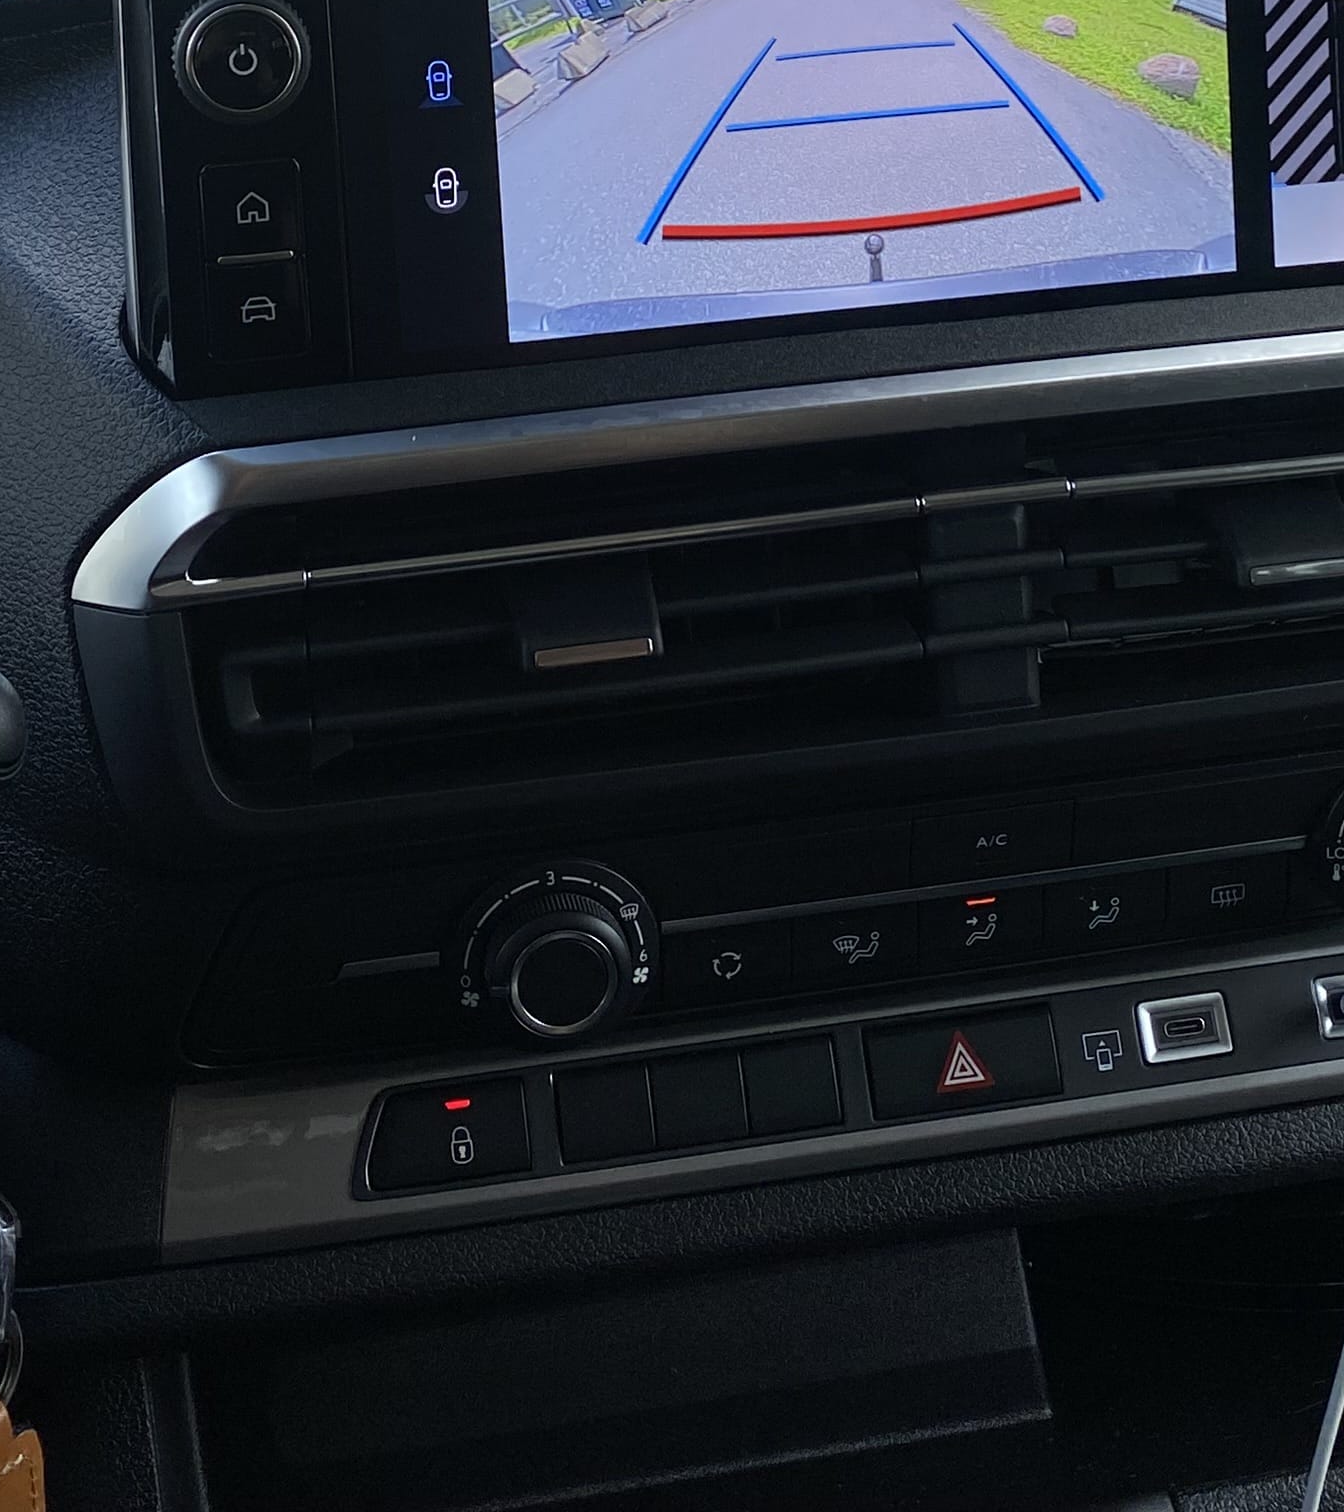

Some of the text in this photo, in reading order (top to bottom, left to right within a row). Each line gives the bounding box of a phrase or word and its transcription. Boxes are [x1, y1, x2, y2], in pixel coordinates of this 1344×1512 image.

[975, 833, 1008, 848] A/C
[545, 871, 555, 886] 3
[640, 949, 648, 962] 6
